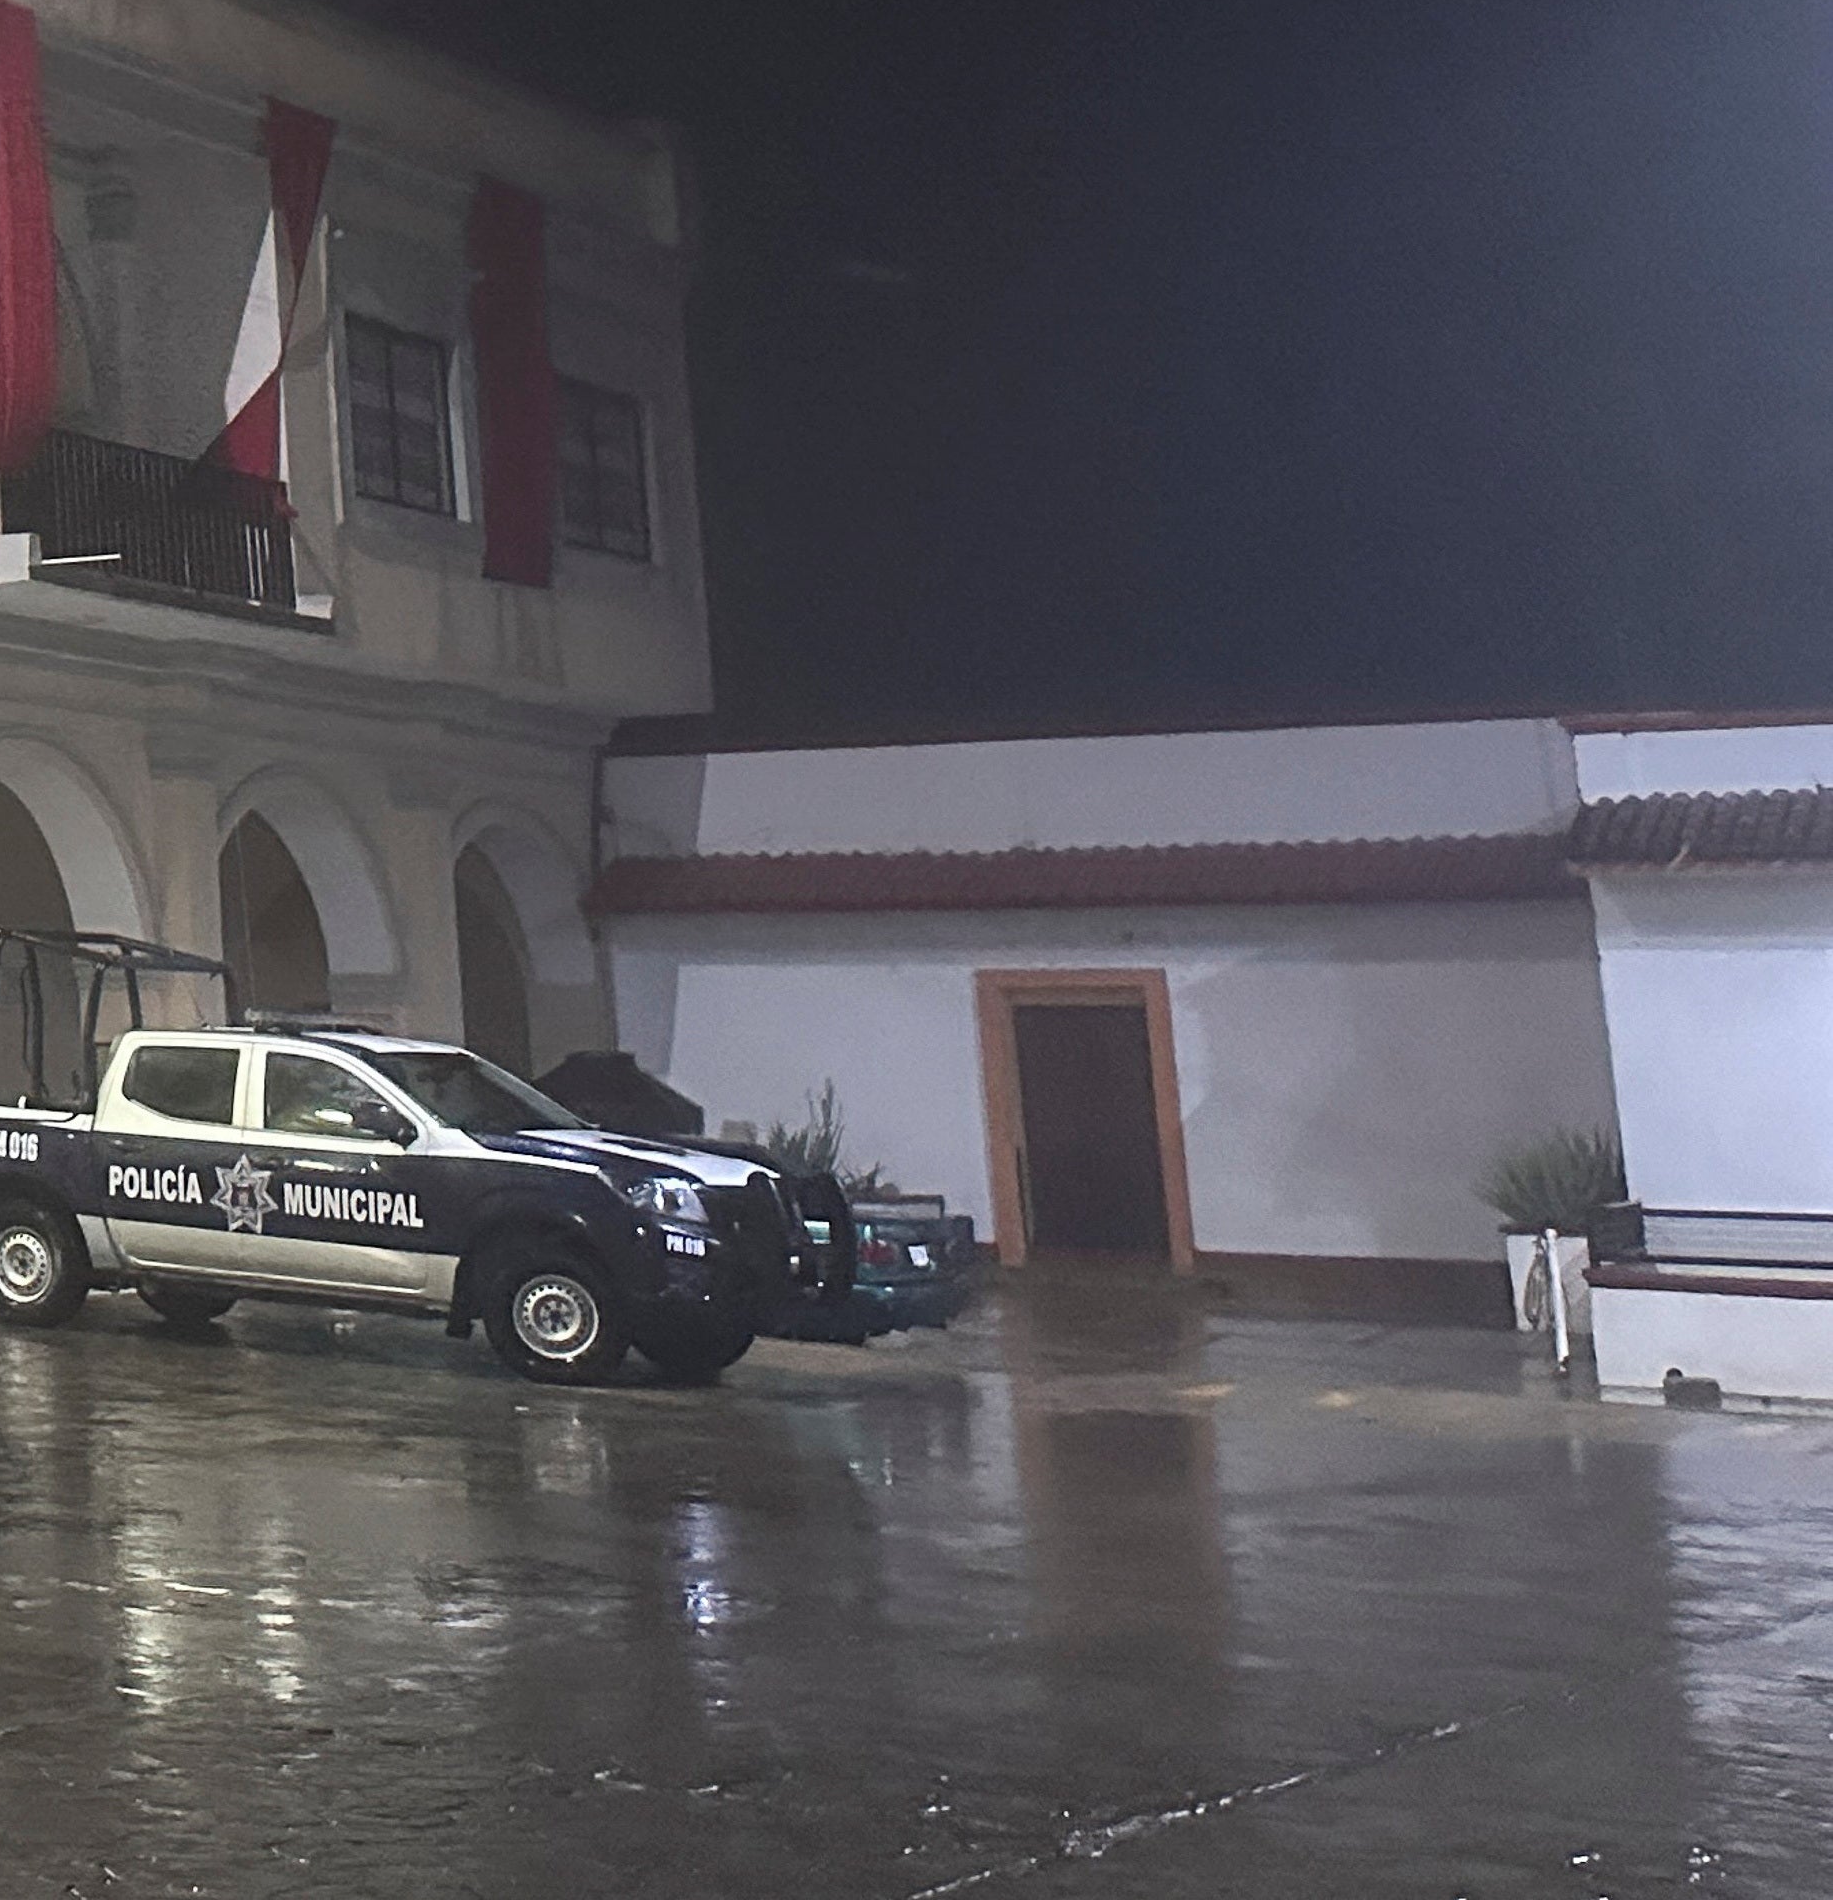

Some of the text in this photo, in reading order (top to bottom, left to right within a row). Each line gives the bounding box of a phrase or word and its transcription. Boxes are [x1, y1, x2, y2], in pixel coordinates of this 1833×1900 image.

[9, 1131, 39, 1162] 016
[108, 1164, 424, 1228] POLICÍA MUNICIPAL
[666, 1233, 684, 1253] PM
